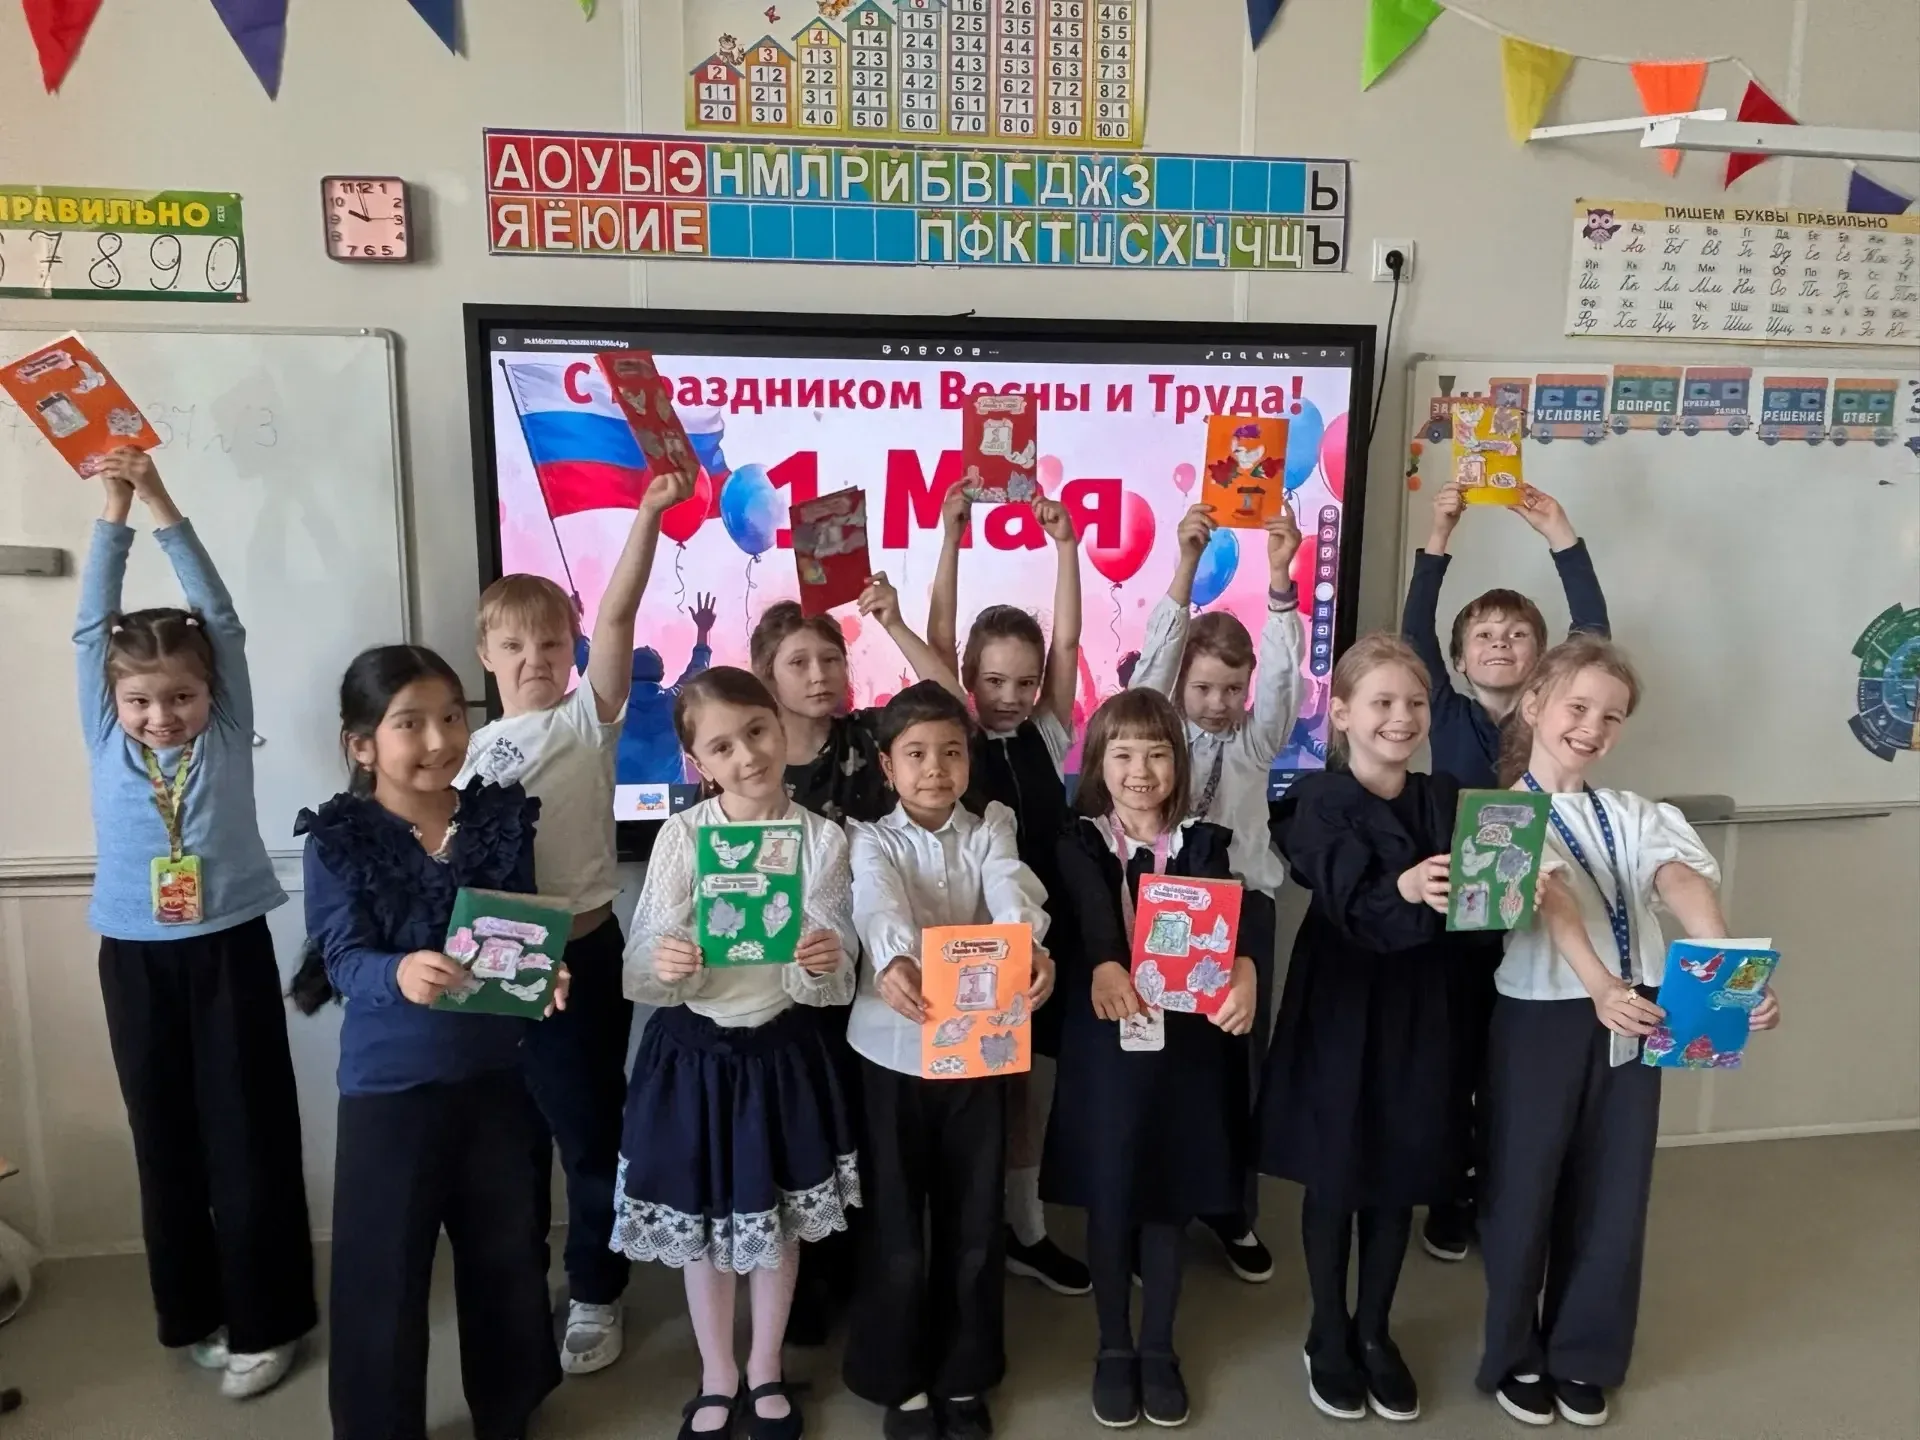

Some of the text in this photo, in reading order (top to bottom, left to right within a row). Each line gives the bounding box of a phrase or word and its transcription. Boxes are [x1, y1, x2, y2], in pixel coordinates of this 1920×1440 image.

[340, 183, 387, 194] 11 12 1
[331, 197, 402, 208] 10 2
[394, 215, 403, 225] 3
[1665, 206, 1888, 229] ПИШЕМ БУКВЫ ПРАВИЛЬНО
[396, 232, 404, 240] 4
[347, 245, 393, 256] 7 6 5
[29, 230, 239, 292] 7 8 9 0
[563, 361, 592, 404] С
[612, 374, 921, 414] аздником
[1107, 386, 1132, 412] и
[1147, 374, 1304, 424] Труда!
[1617, 400, 1671, 412] ВОПРОС
[1537, 409, 1602, 422] УСЛОВИЕ
[1763, 410, 1824, 422] РЕШЕНИЕ
[1843, 412, 1882, 423] ОТВЕТ
[882, 449, 1121, 551] Мая
